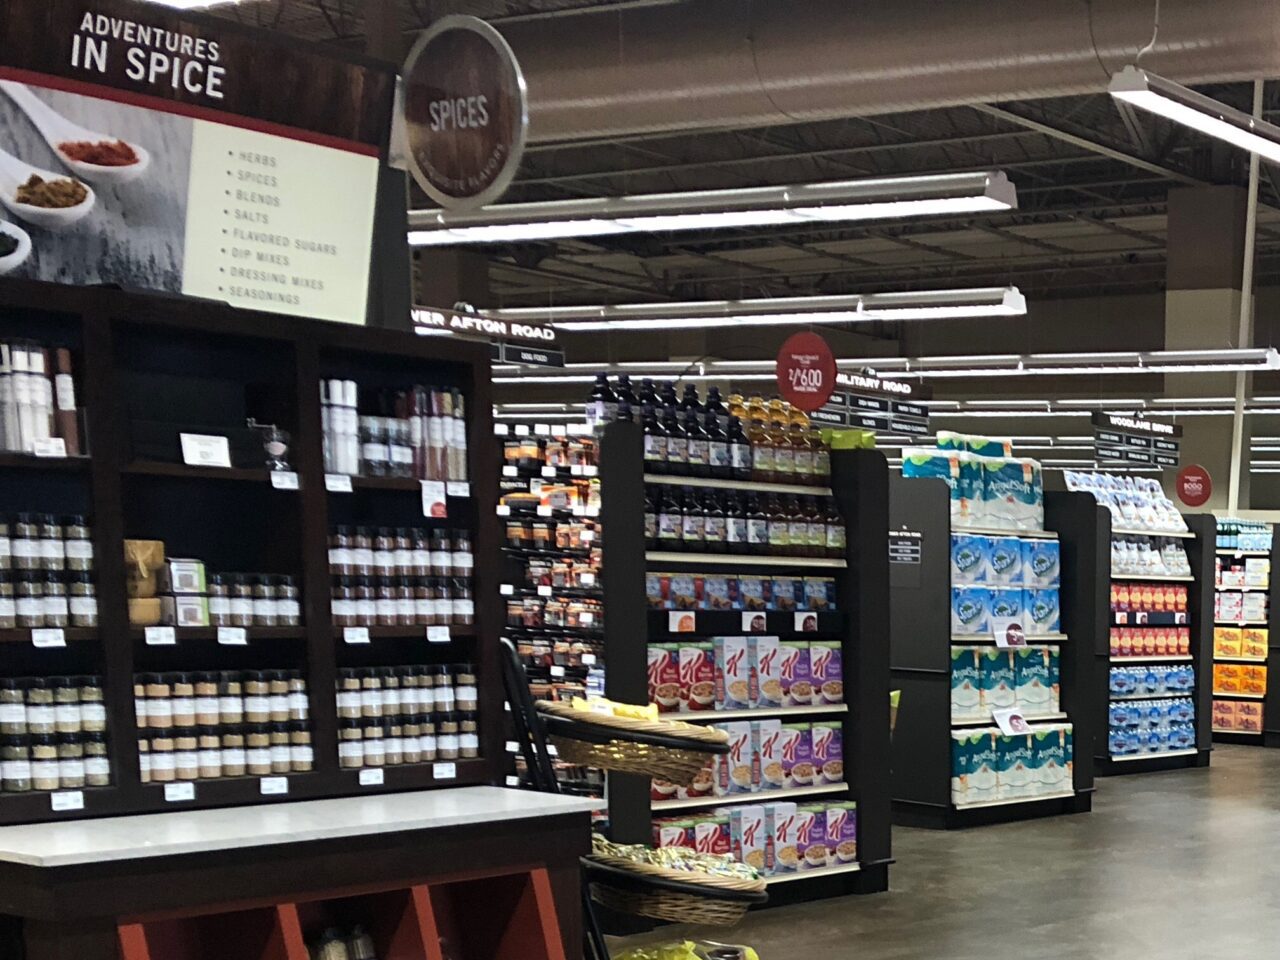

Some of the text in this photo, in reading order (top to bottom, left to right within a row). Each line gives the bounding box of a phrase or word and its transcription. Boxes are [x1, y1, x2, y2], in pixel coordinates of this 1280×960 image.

[80, 12, 219, 62] ADVENTURES
[71, 34, 226, 98] IN SPICE
[429, 94, 489, 132] SPICES
[239, 152, 277, 168] HERBS
[237, 170, 278, 187] SPICES
[236, 189, 280, 207] BLENDS
[234, 209, 269, 225] SALTS
[233, 228, 337, 256] FLAVORED SUGARS
[231, 247, 290, 266] DIP MIXES
[230, 266, 324, 291] DRESSING MIXES
[229, 286, 300, 305] SEASONINGS
[450, 315, 507, 334] AFTON
[511, 324, 555, 341] ROAD
[883, 380, 911, 393] ROAD
[681, 651, 703, 684] K
[726, 649, 745, 677] K
[760, 648, 777, 676] K
[781, 650, 799, 680] K
[813, 650, 832, 680] K
[763, 732, 779, 759] K
[815, 731, 833, 760] K
[776, 815, 794, 843] K
[829, 812, 847, 841] K
